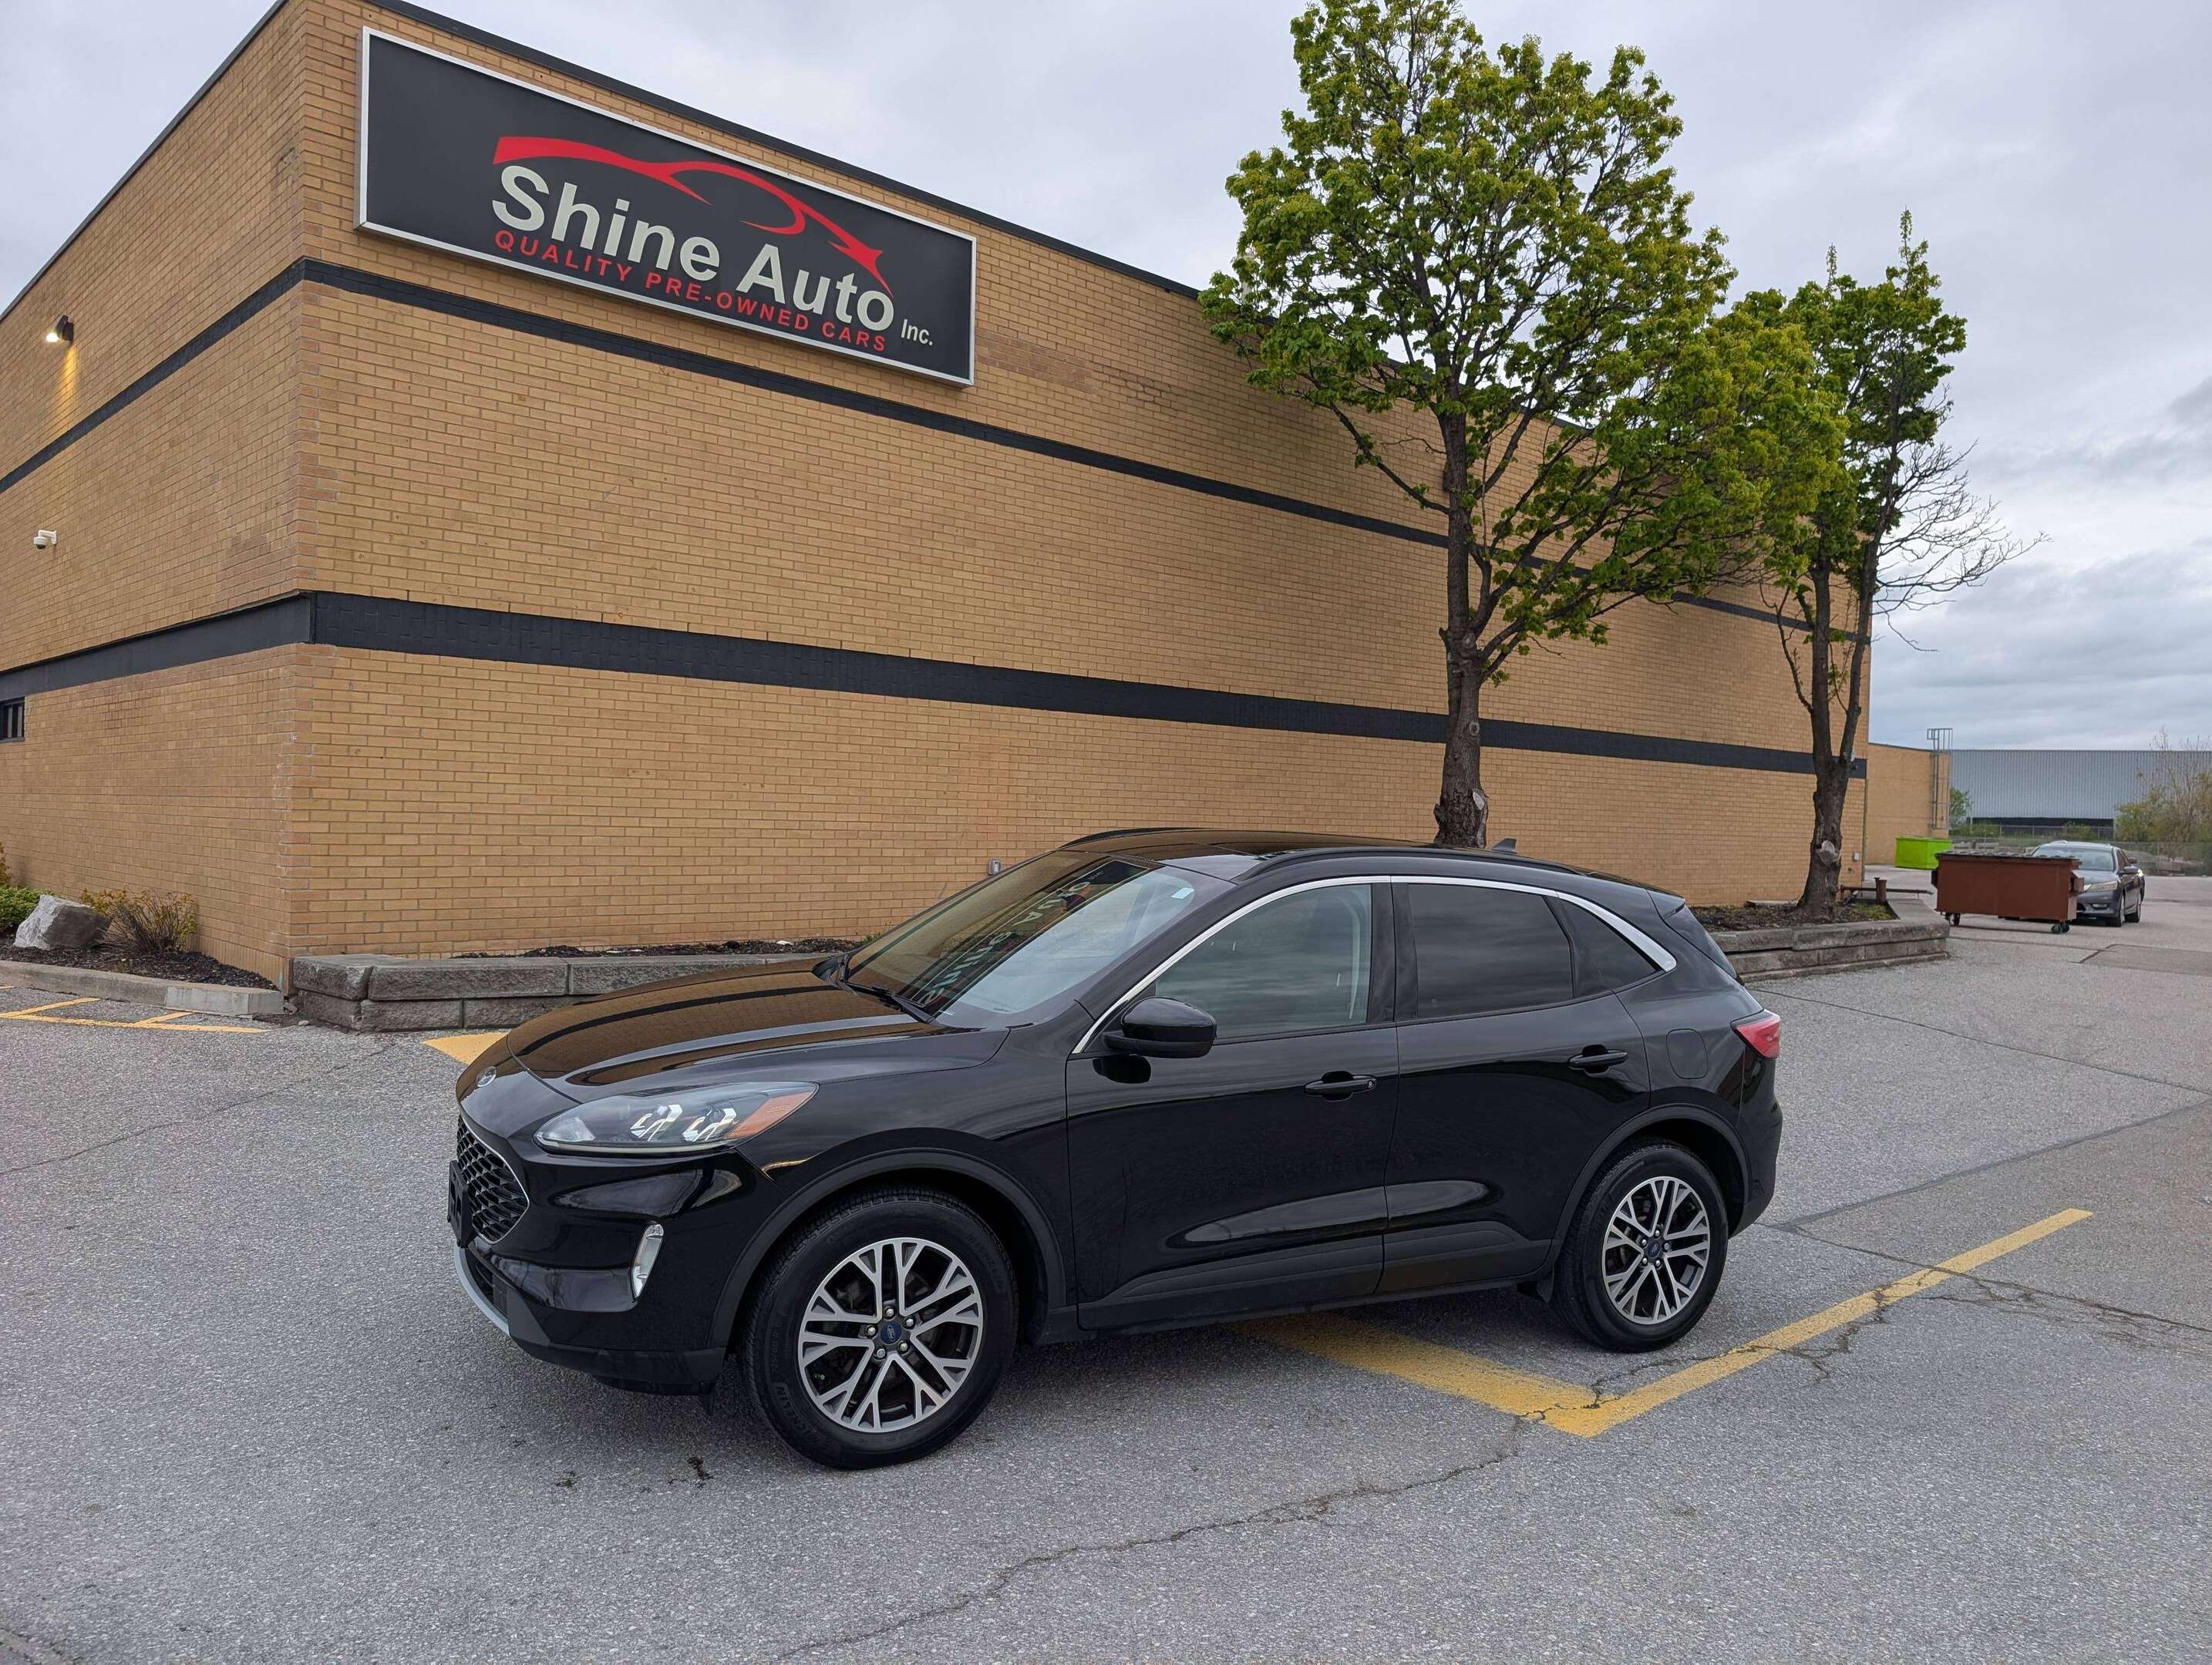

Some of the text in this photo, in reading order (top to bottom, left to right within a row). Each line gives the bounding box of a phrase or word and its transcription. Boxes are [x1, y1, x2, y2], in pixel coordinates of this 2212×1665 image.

[492, 165, 934, 346] Shine Auto Inc.
[494, 230, 886, 352] QUALITY PRE-OWNED CARS
[775, 1385, 823, 1442] MICHELIN
